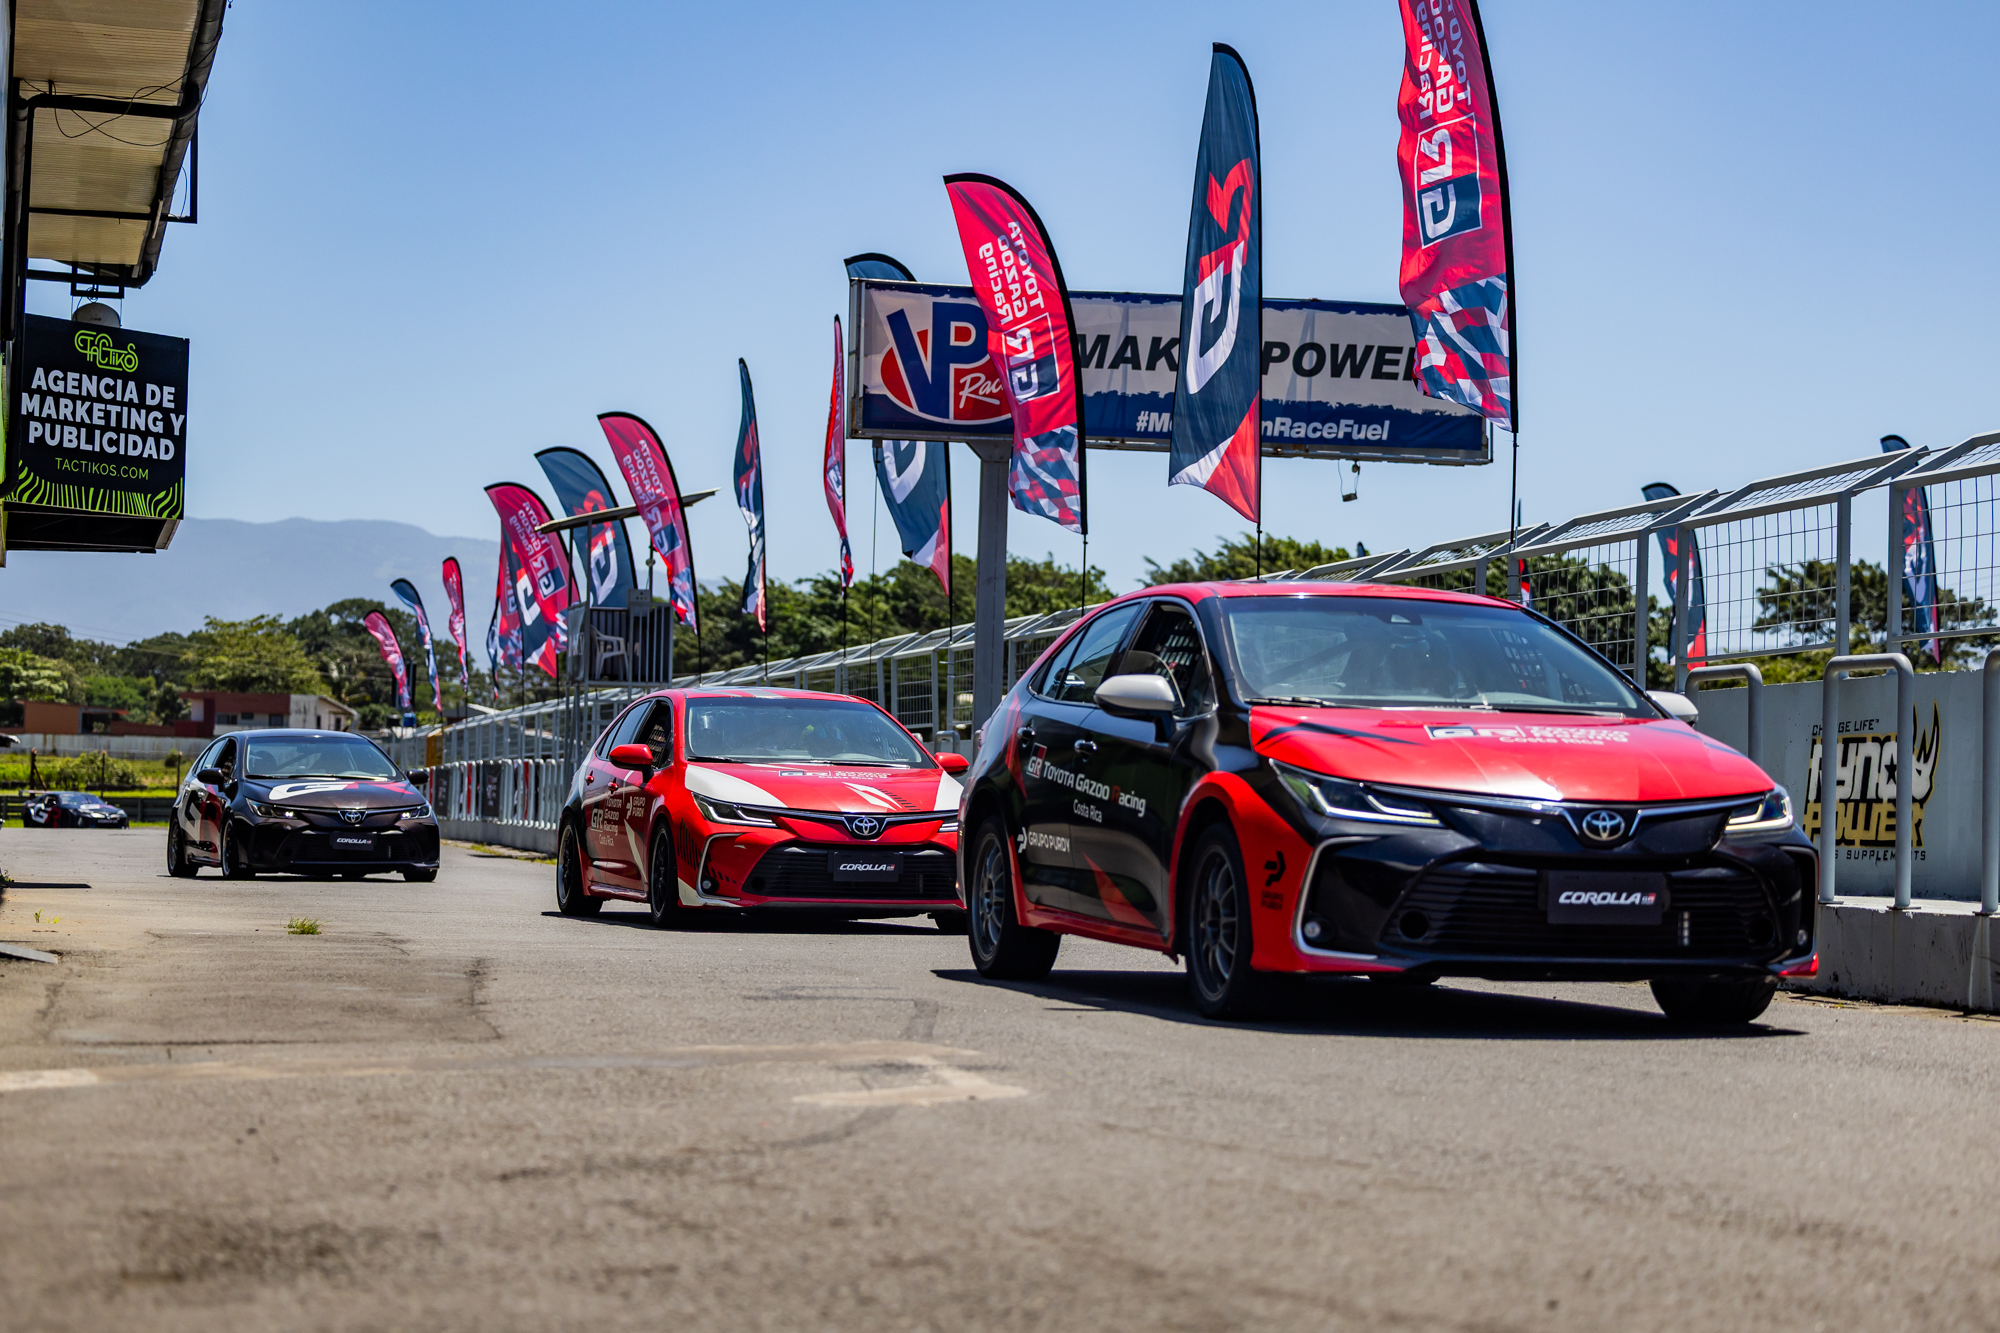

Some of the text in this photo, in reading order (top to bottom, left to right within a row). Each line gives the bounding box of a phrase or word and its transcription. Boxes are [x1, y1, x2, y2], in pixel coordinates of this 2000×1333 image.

[886, 301, 989, 421] VP
[1076, 333, 1181, 373] MAK
[31, 366, 176, 409] AGENCIA DE
[958, 372, 1004, 409] Rac
[20, 392, 186, 436] MARKETING Y
[28, 420, 176, 461] PUBLICIDAD
[54, 457, 150, 481] TACTIKOS.COM
[1027, 756, 1147, 818] GR TOYOTA GAZOO Racing
[1073, 798, 1103, 823] Costa Rica
[336, 837, 367, 845] COROLLA
[1846, 849, 1927, 861] SUPPLEMTS
[839, 863, 887, 871] COROLLA
[1558, 890, 1642, 905] COROLLA
